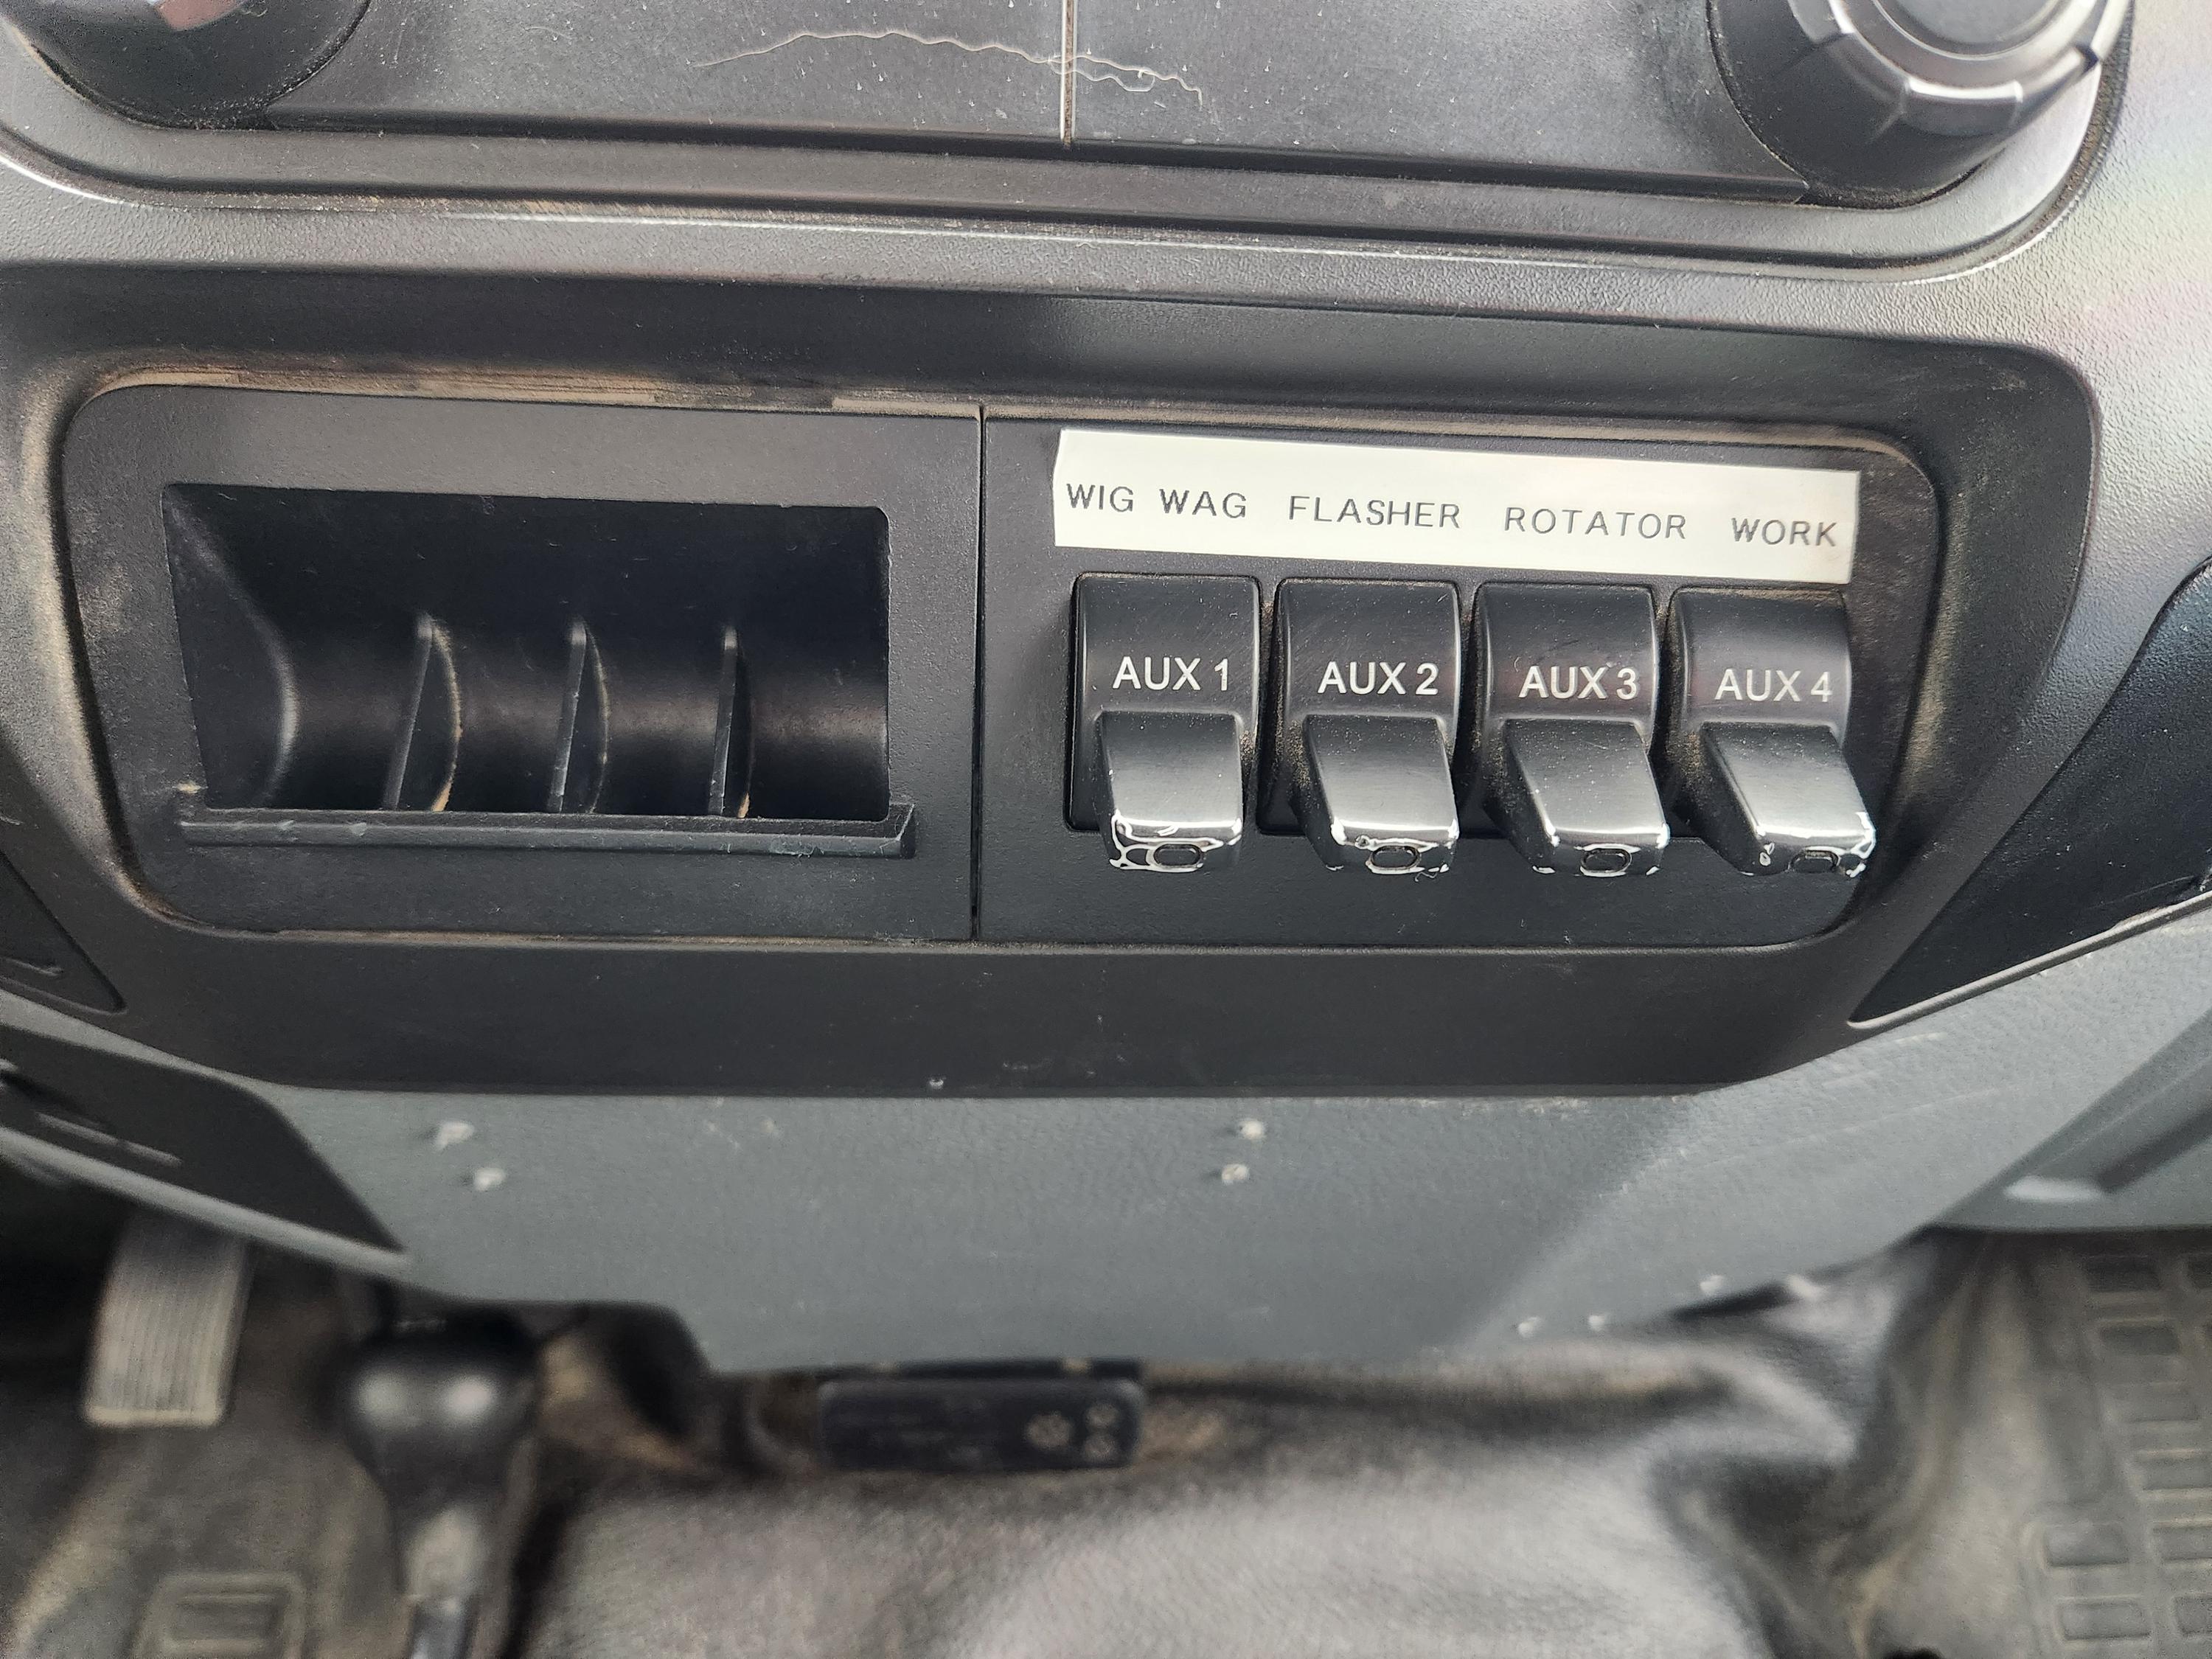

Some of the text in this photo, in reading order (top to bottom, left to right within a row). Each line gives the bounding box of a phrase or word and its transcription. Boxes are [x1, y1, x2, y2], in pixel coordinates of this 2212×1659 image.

[1067, 483, 1837, 547] WIG WAG FLASHER ROTATOR WORK
[1113, 656, 1228, 691] AUX 1
[1318, 661, 1439, 695] AUX 2
[1519, 666, 1638, 700] AUX 3
[1714, 669, 1833, 702] AUX 4
